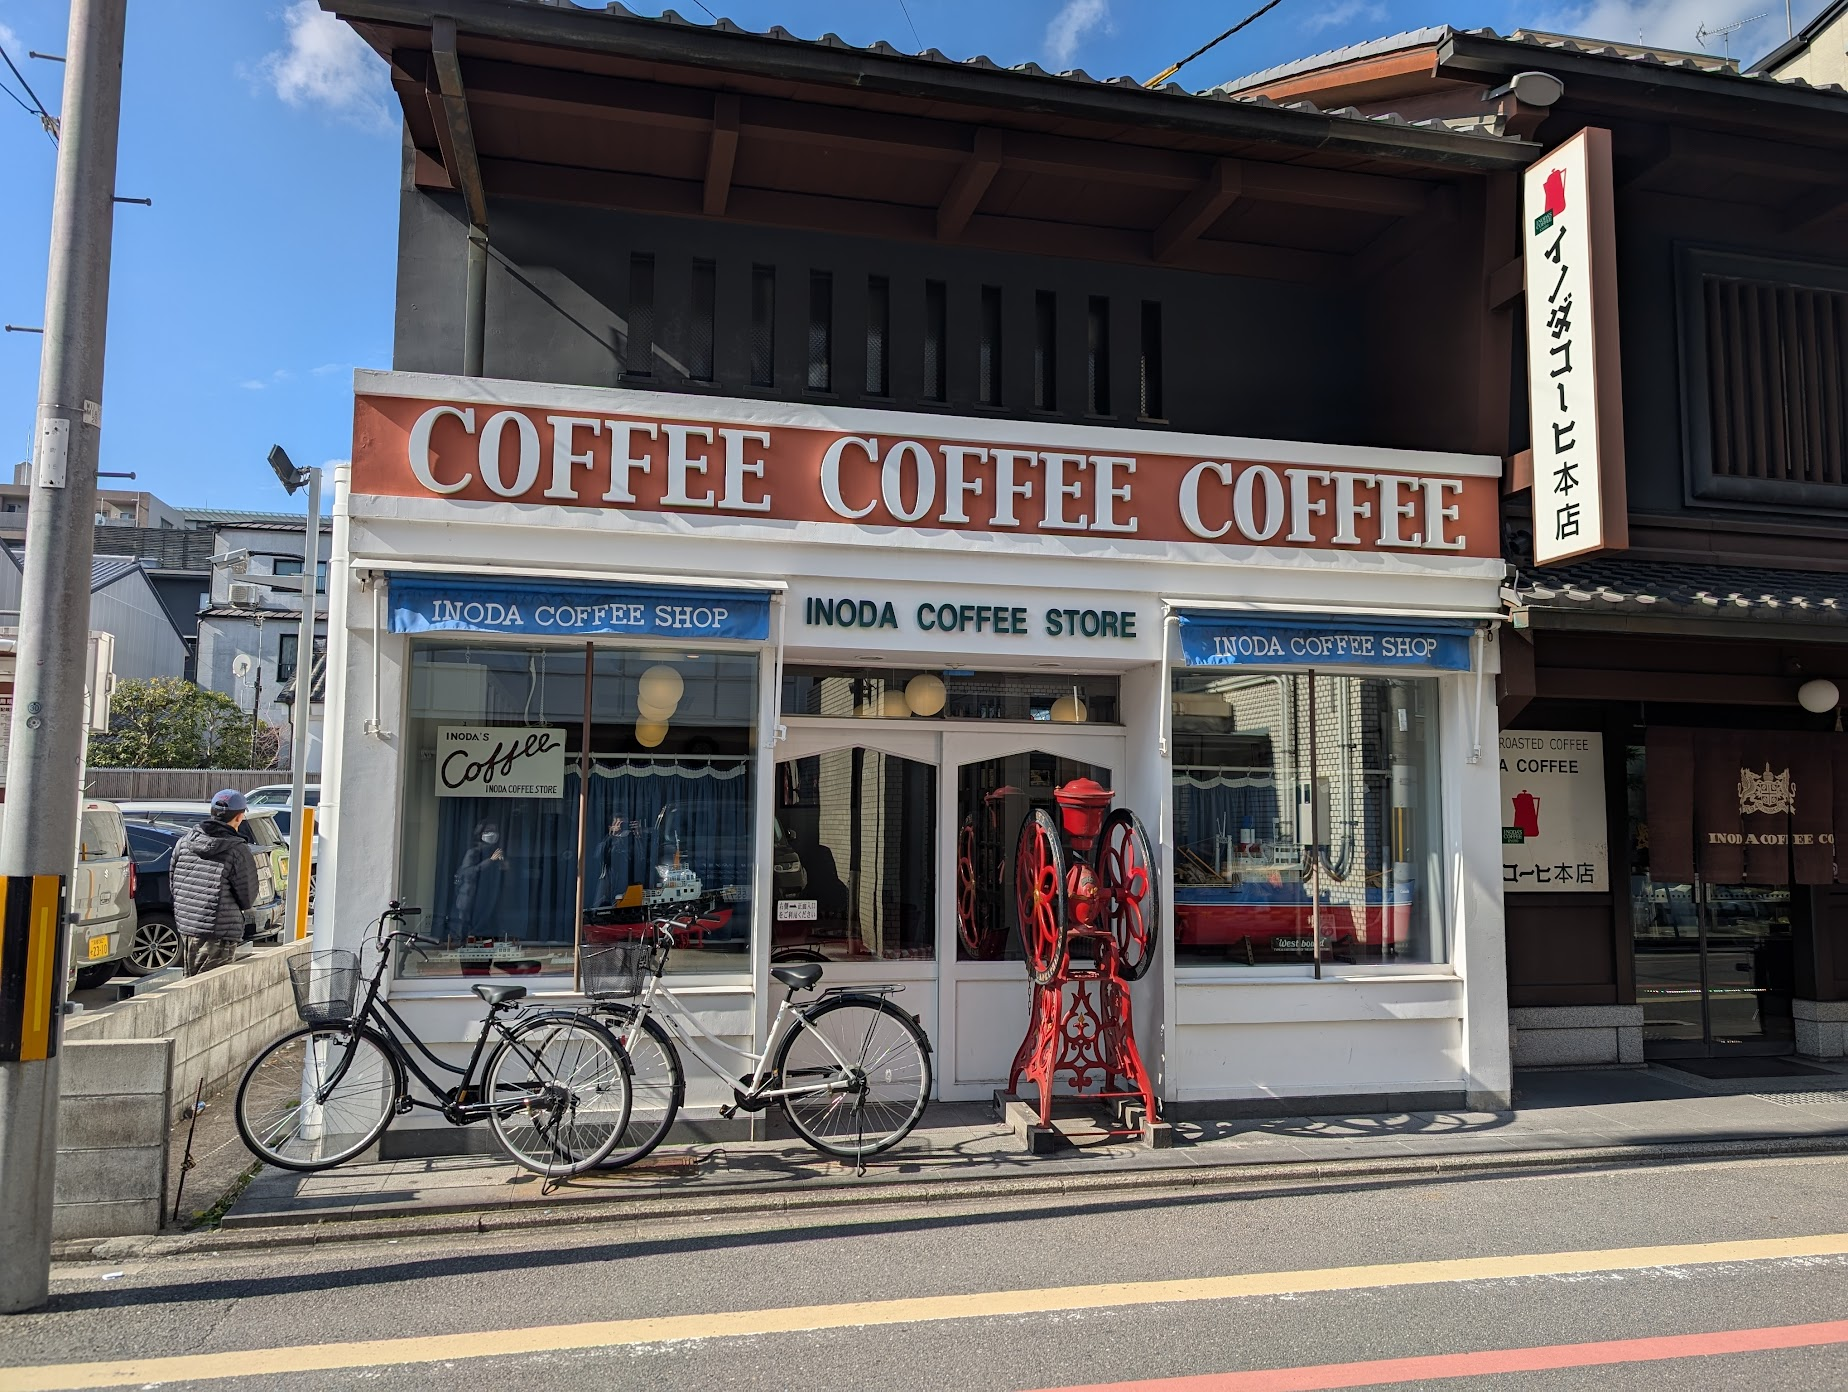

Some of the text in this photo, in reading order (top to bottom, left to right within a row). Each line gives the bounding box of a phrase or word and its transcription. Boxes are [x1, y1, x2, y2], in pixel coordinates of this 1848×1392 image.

[1544, 225, 1580, 541] イノダコーヒ本店
[409, 406, 1466, 550] COFFEE COFFEE COFFEE
[431, 600, 729, 628] INODA COFFEE SHOP
[806, 597, 1137, 638] INODA COFFEE STORE
[1214, 635, 1437, 658] INODA COFFEE SHOP
[446, 732, 490, 741] INODA'S
[1499, 737, 1589, 751] ROASTED COFFEE
[441, 733, 560, 789] Coffee
[1517, 759, 1579, 774] COFFEE
[486, 784, 557, 794] INODA COFFEE STORE
[1503, 862, 1594, 884] コーヒ本店
